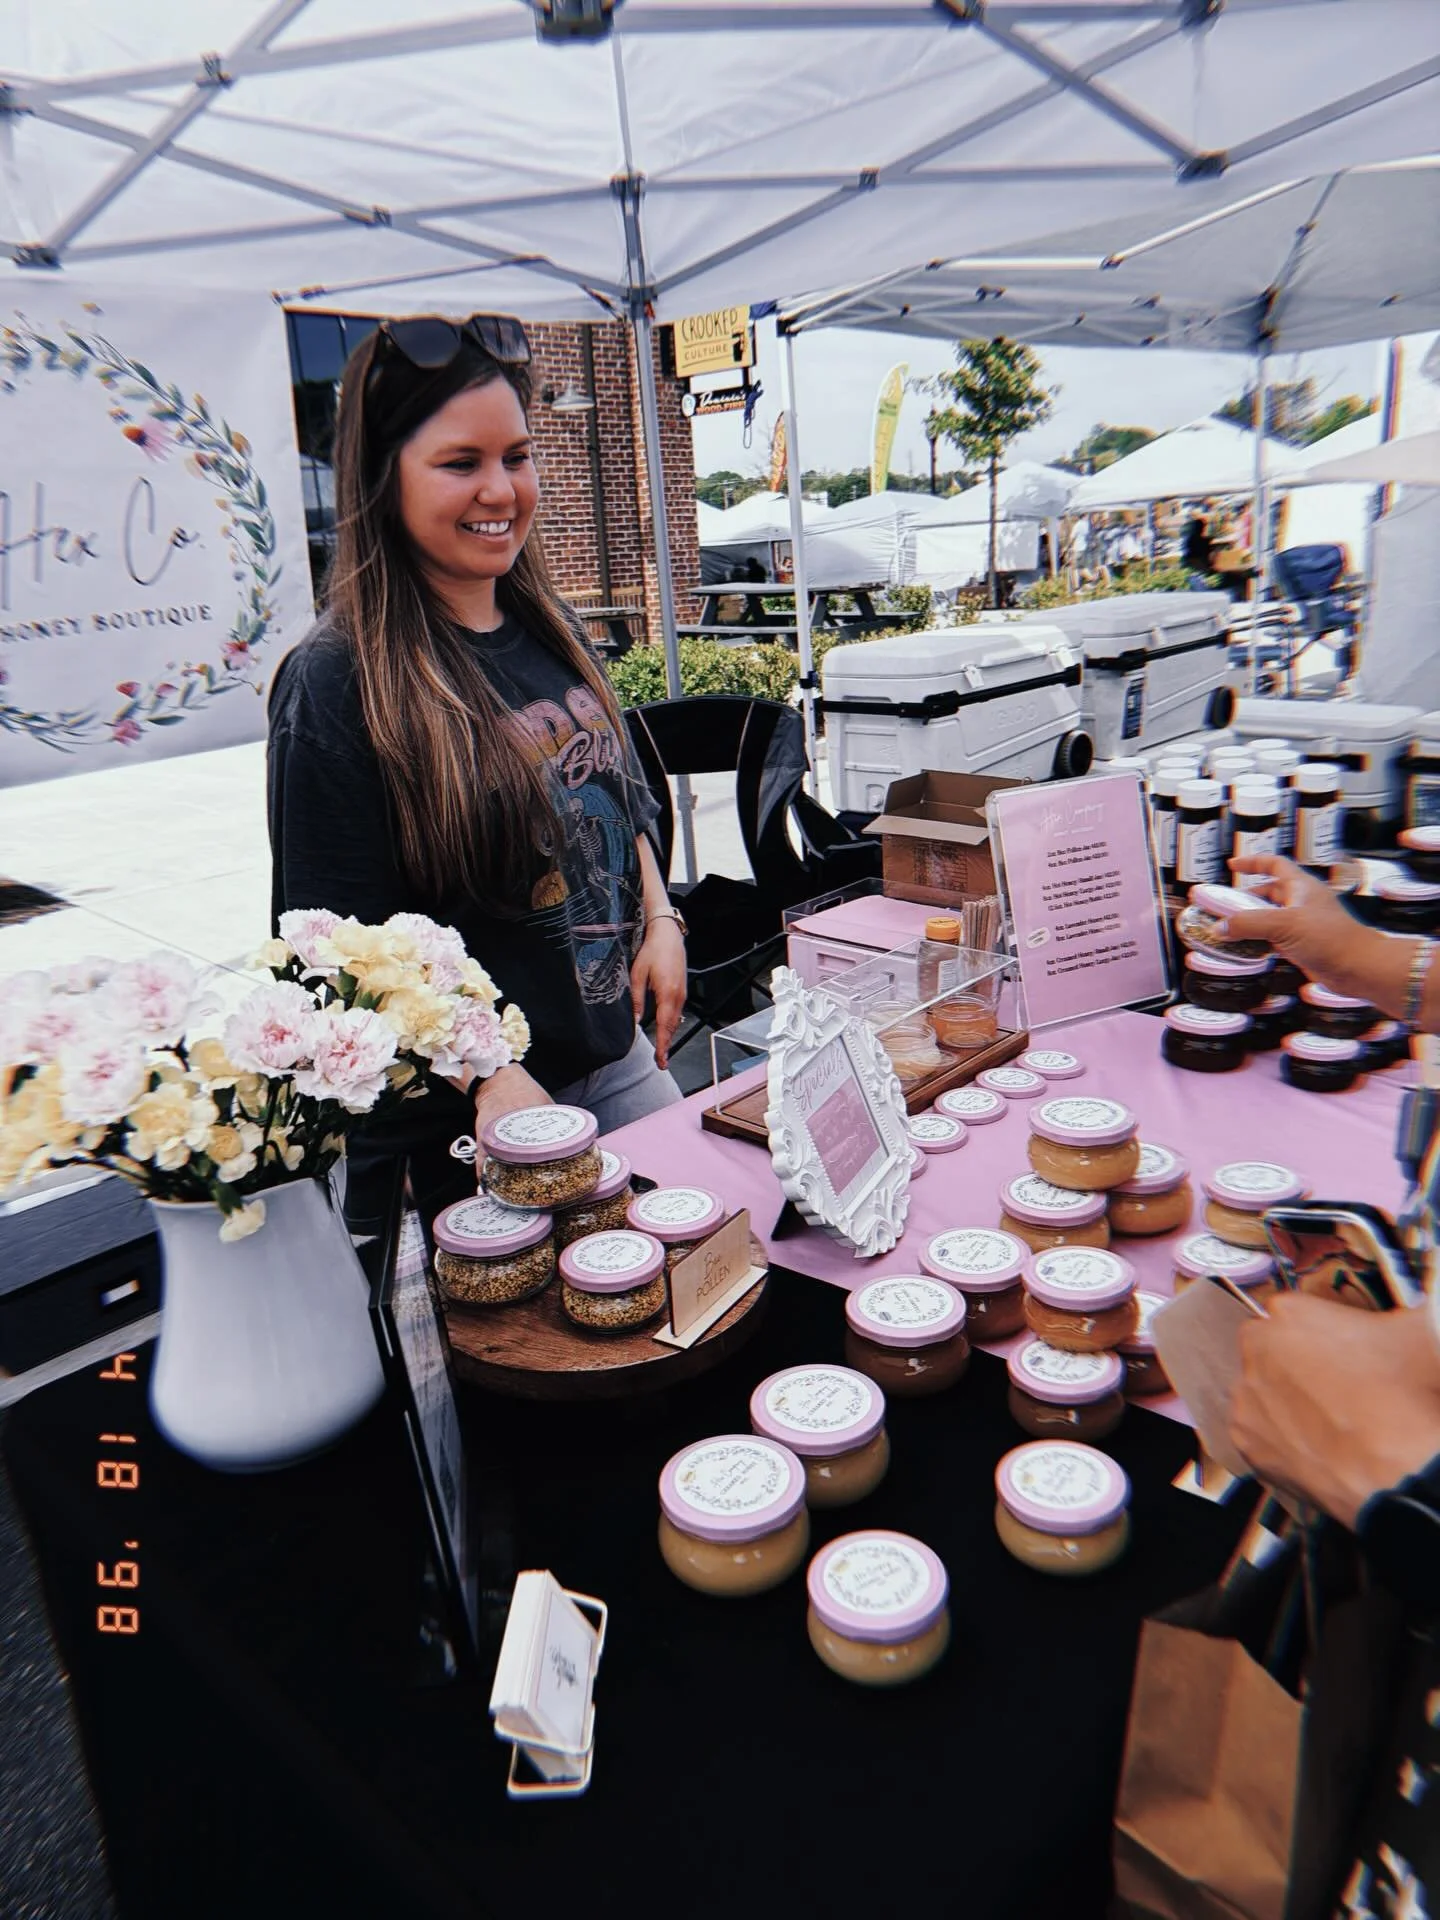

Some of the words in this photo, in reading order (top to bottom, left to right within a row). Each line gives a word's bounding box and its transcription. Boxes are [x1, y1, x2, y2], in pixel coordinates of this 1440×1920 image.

[681, 307, 738, 343] CROOKED
[684, 343, 730, 361] CULTURE
[91, 603, 213, 632] BOUTIQUE
[695, 1263, 731, 1304] POLLEN
